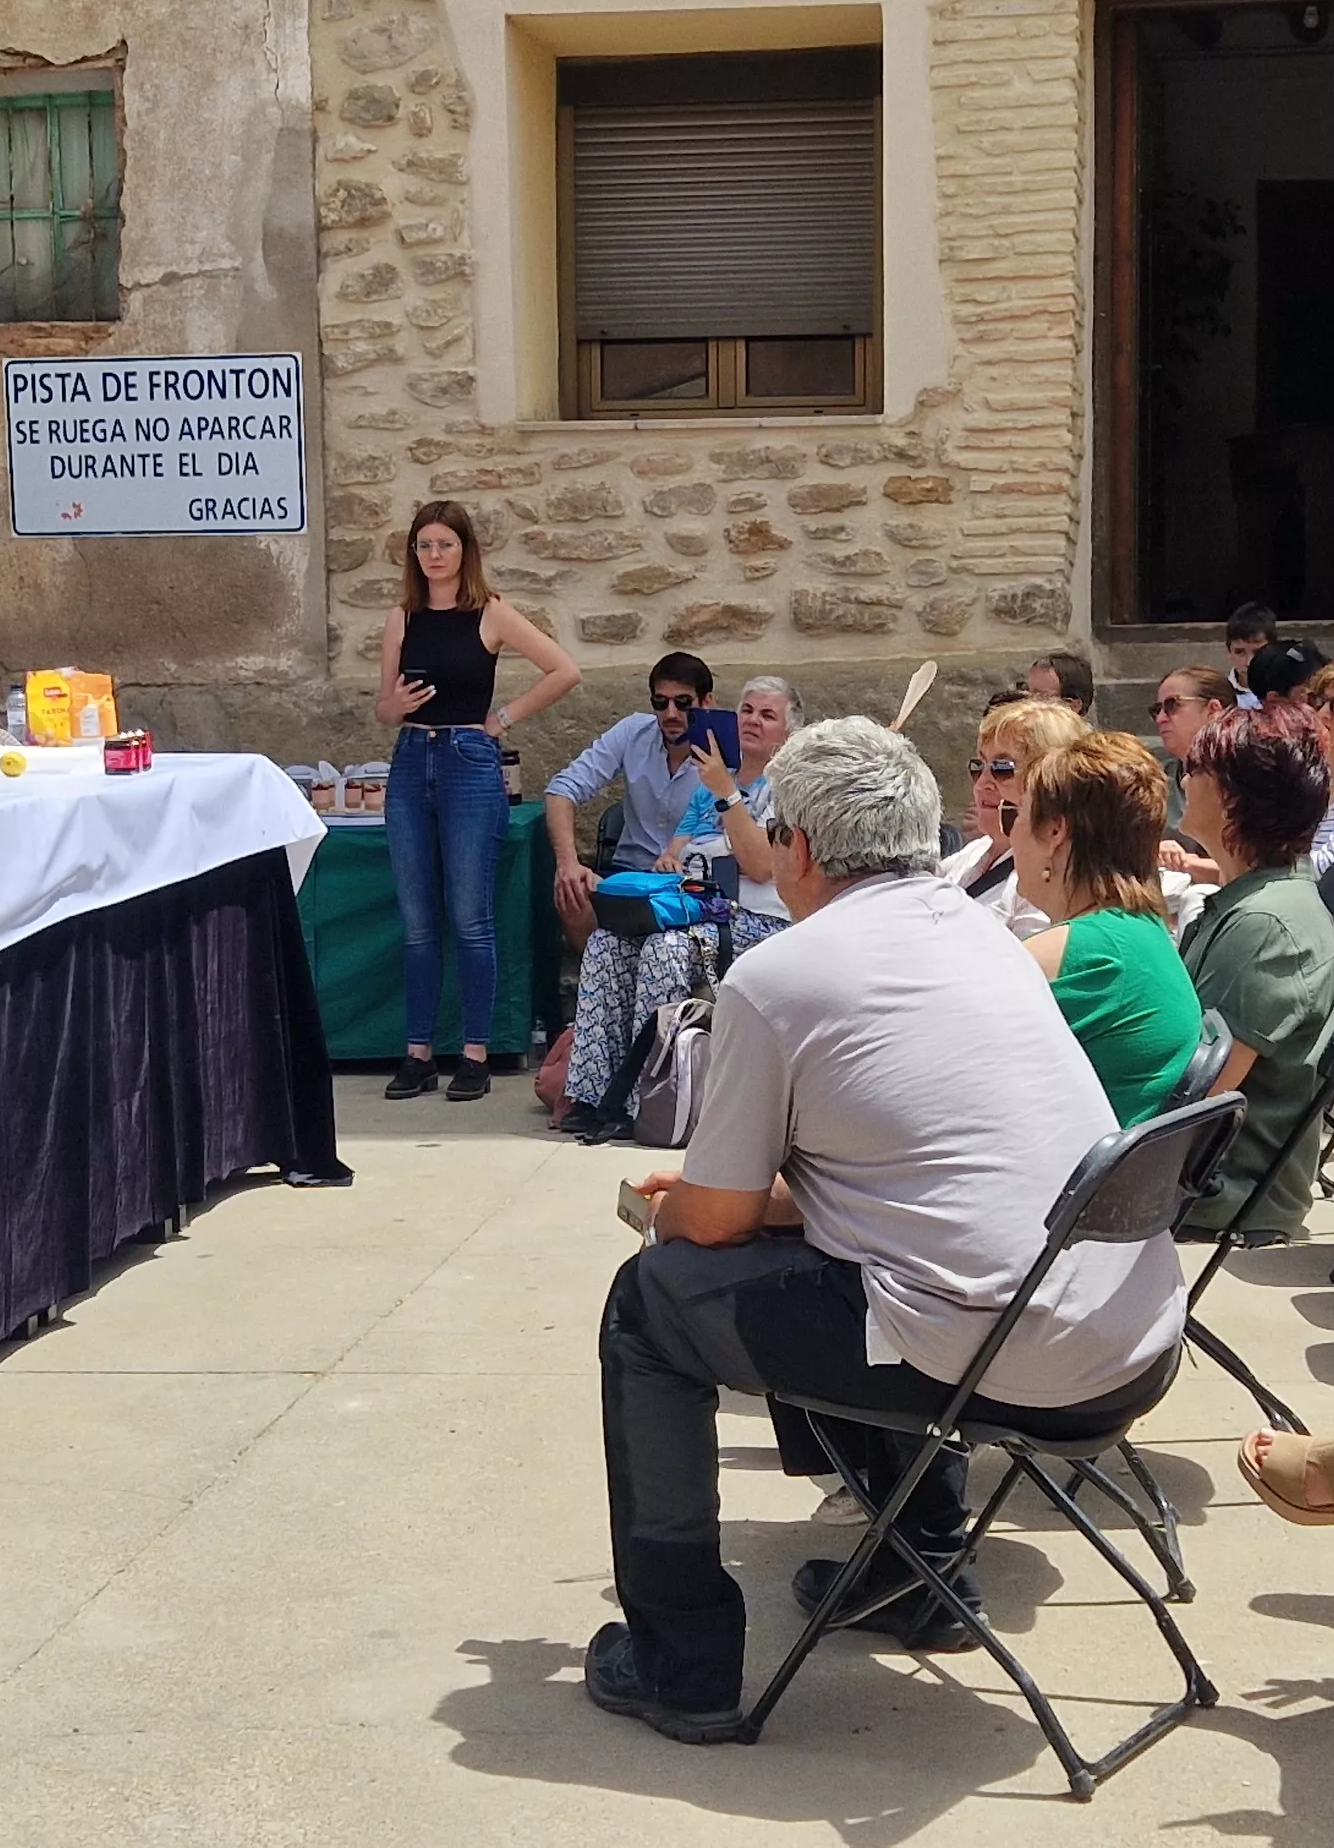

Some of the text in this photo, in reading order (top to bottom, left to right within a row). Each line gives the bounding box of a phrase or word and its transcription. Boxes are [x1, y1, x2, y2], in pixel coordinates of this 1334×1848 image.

[13, 367, 292, 404] PISTA DE FRONTON
[15, 415, 292, 444] SE RUEGA NO APARCAR
[50, 452, 259, 479] DURANTE EL DIA
[189, 497, 288, 522] GRACIAS
